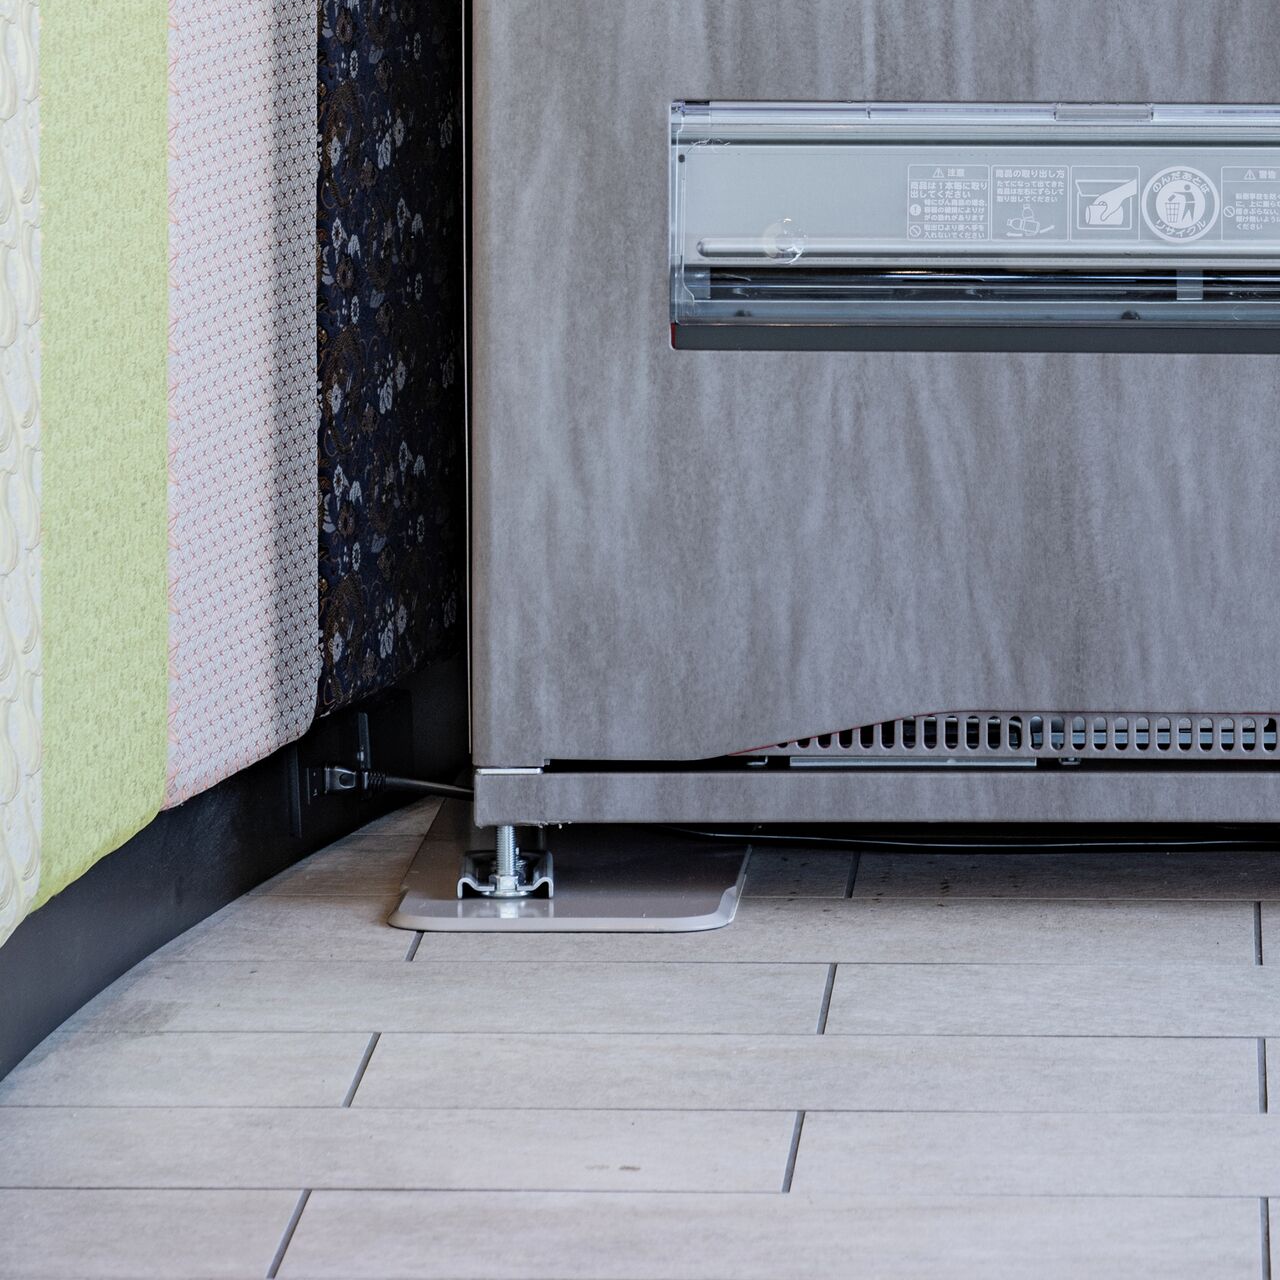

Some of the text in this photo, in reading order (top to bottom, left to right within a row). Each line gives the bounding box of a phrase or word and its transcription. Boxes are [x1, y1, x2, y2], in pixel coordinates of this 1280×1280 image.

[996, 169, 1065, 178] 商品の取り出し方
[1152, 171, 1211, 194] のんだあとは
[910, 190, 971, 199] 出してください
[1154, 219, 1207, 238] リサイクル
